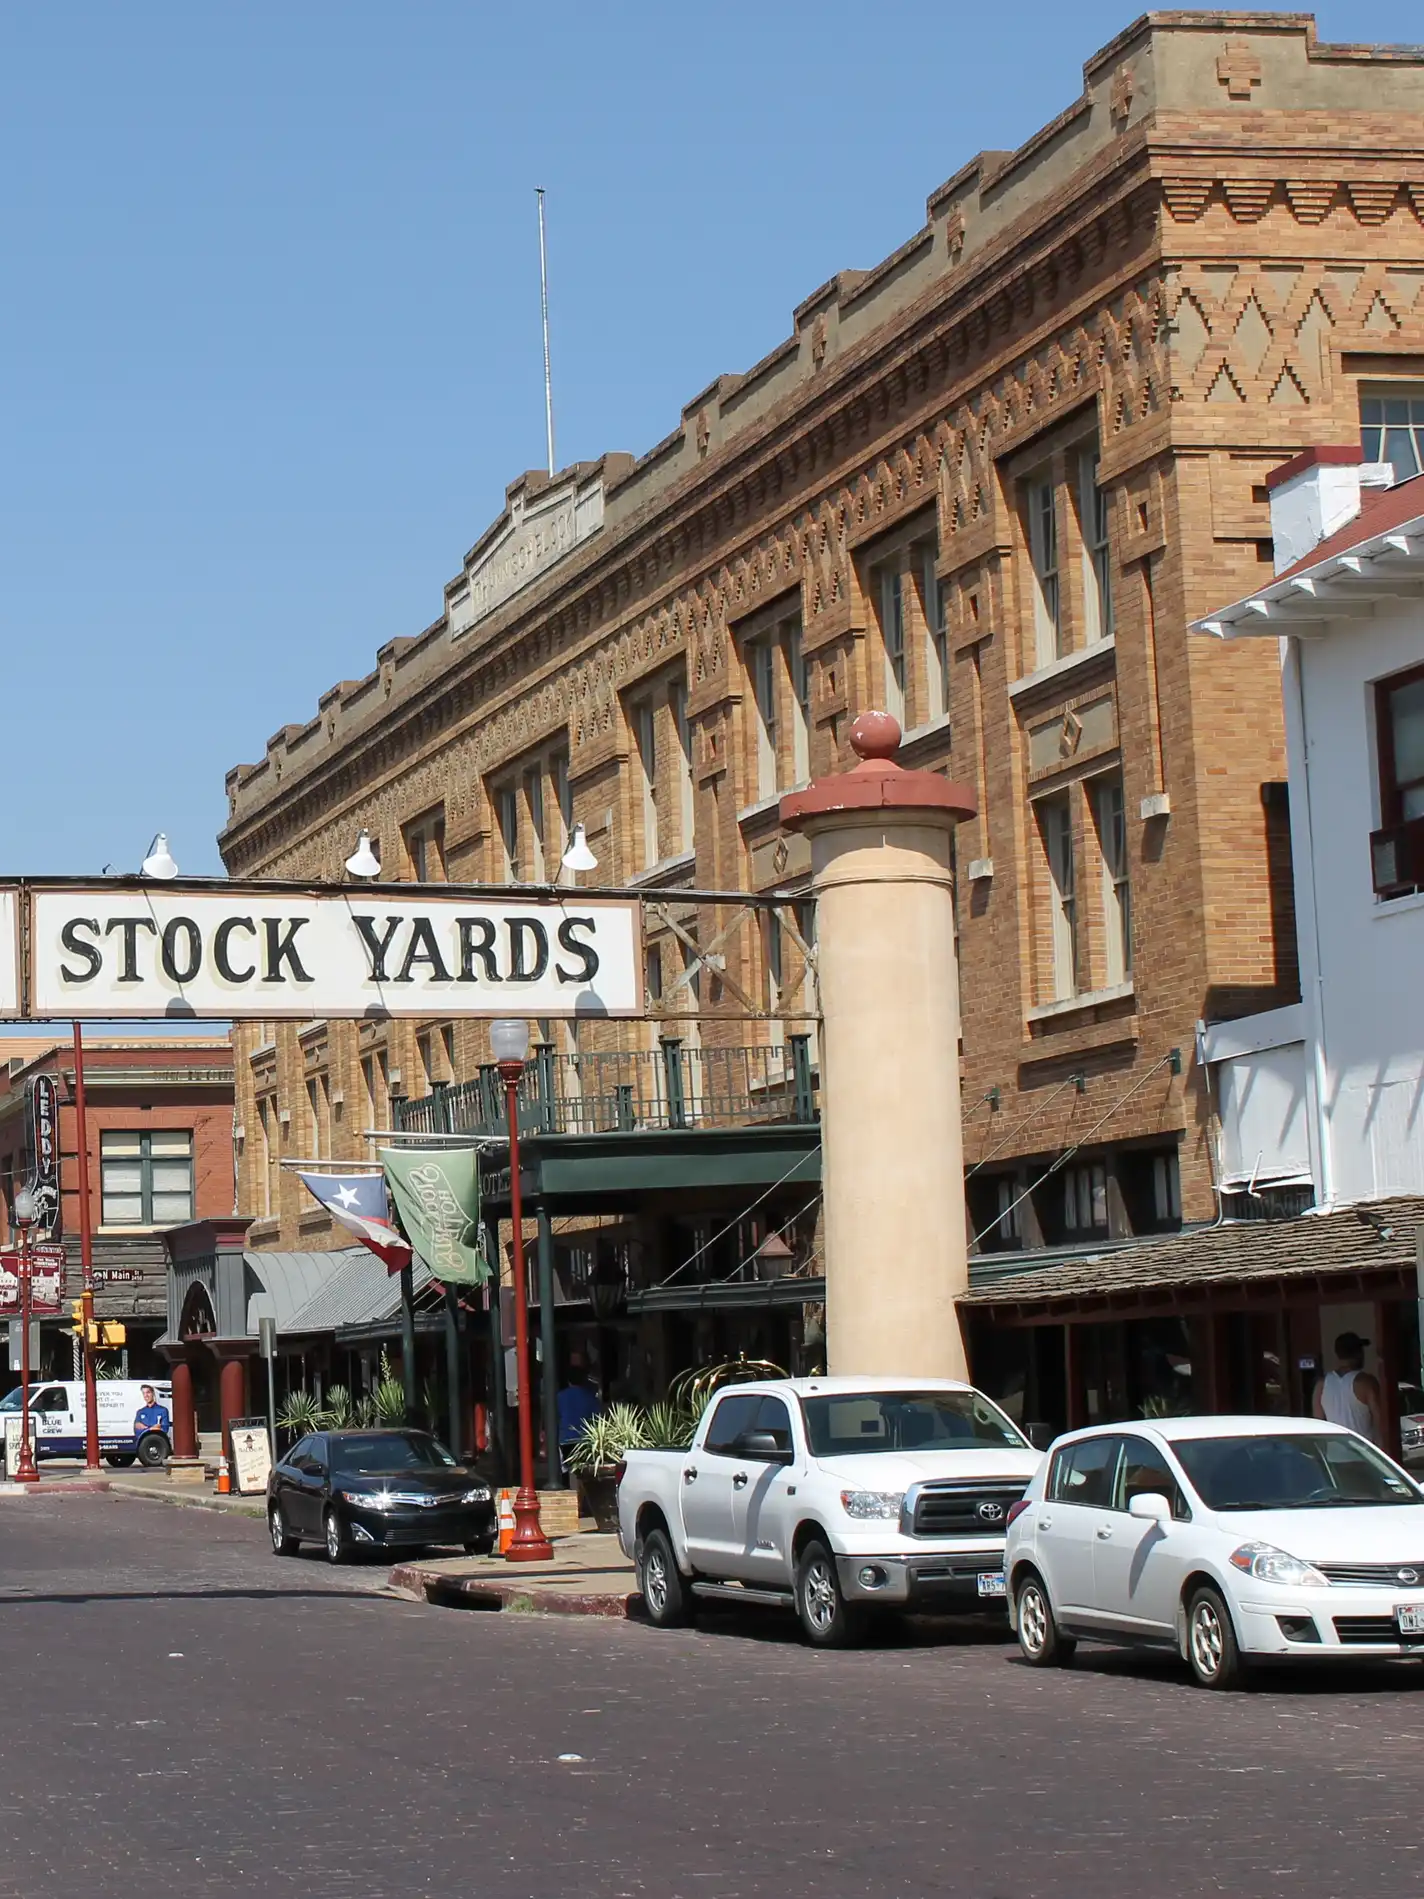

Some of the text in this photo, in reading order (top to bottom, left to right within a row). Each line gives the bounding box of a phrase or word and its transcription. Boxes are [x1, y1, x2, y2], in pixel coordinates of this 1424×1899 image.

[60, 917, 309, 983] STOCK
[352, 916, 599, 983] YARDS
[39, 1080, 52, 1175] LEDDY
[103, 1271, 108, 1280] N
[111, 1270, 130, 1280] Main
